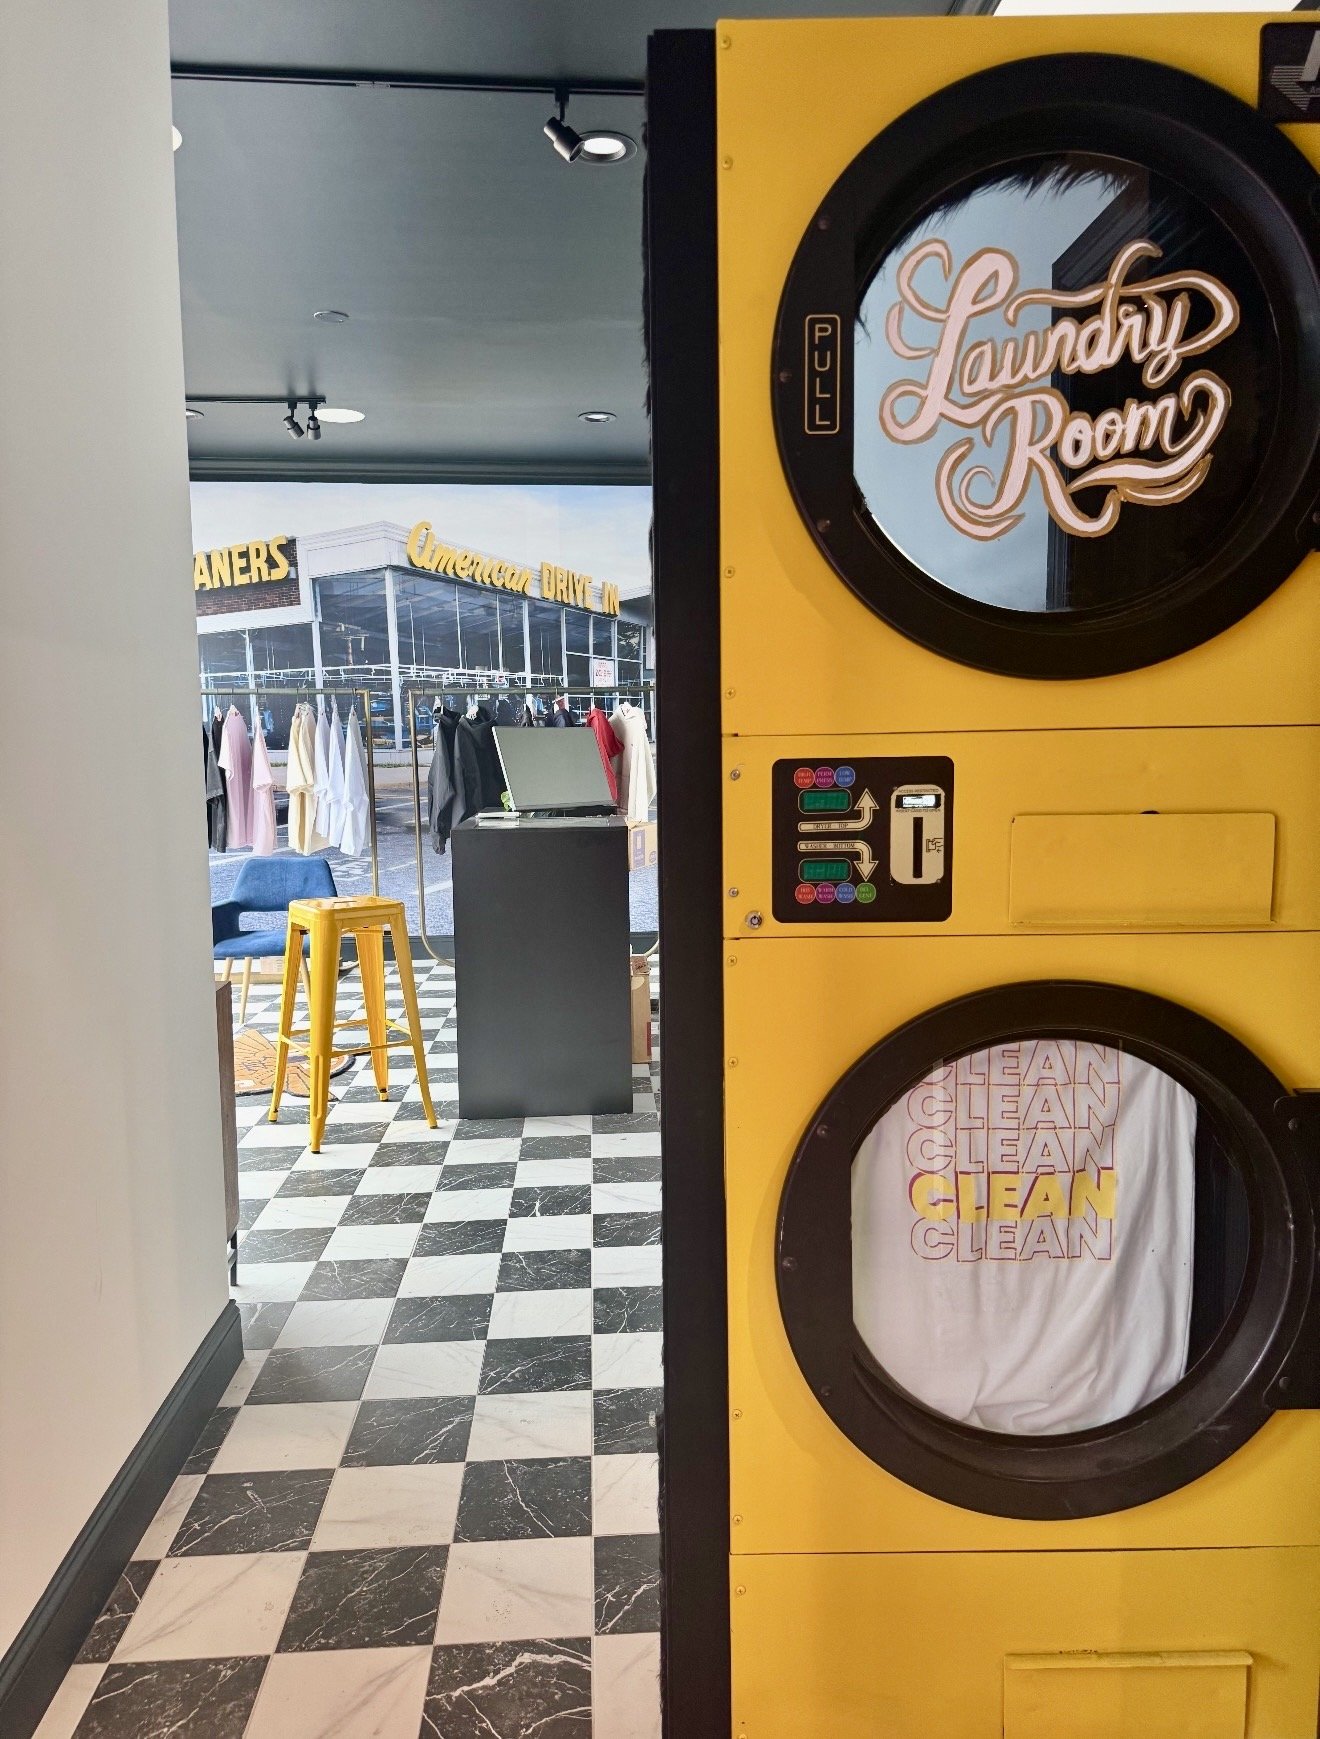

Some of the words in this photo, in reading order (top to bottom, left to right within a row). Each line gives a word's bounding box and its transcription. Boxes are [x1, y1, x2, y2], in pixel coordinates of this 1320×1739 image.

[879, 238, 1239, 445] Laundry
[813, 323, 832, 426] PULL
[935, 369, 1232, 541] Room
[193, 535, 290, 591] ANERS
[540, 561, 593, 610] DRIVE
[602, 581, 620, 616] IN
[907, 1084, 1120, 1129] CLEAN
[906, 1127, 1115, 1174] CLEAN
[908, 1170, 1117, 1223] CLEAN
[910, 1217, 1113, 1263] CLEAN
